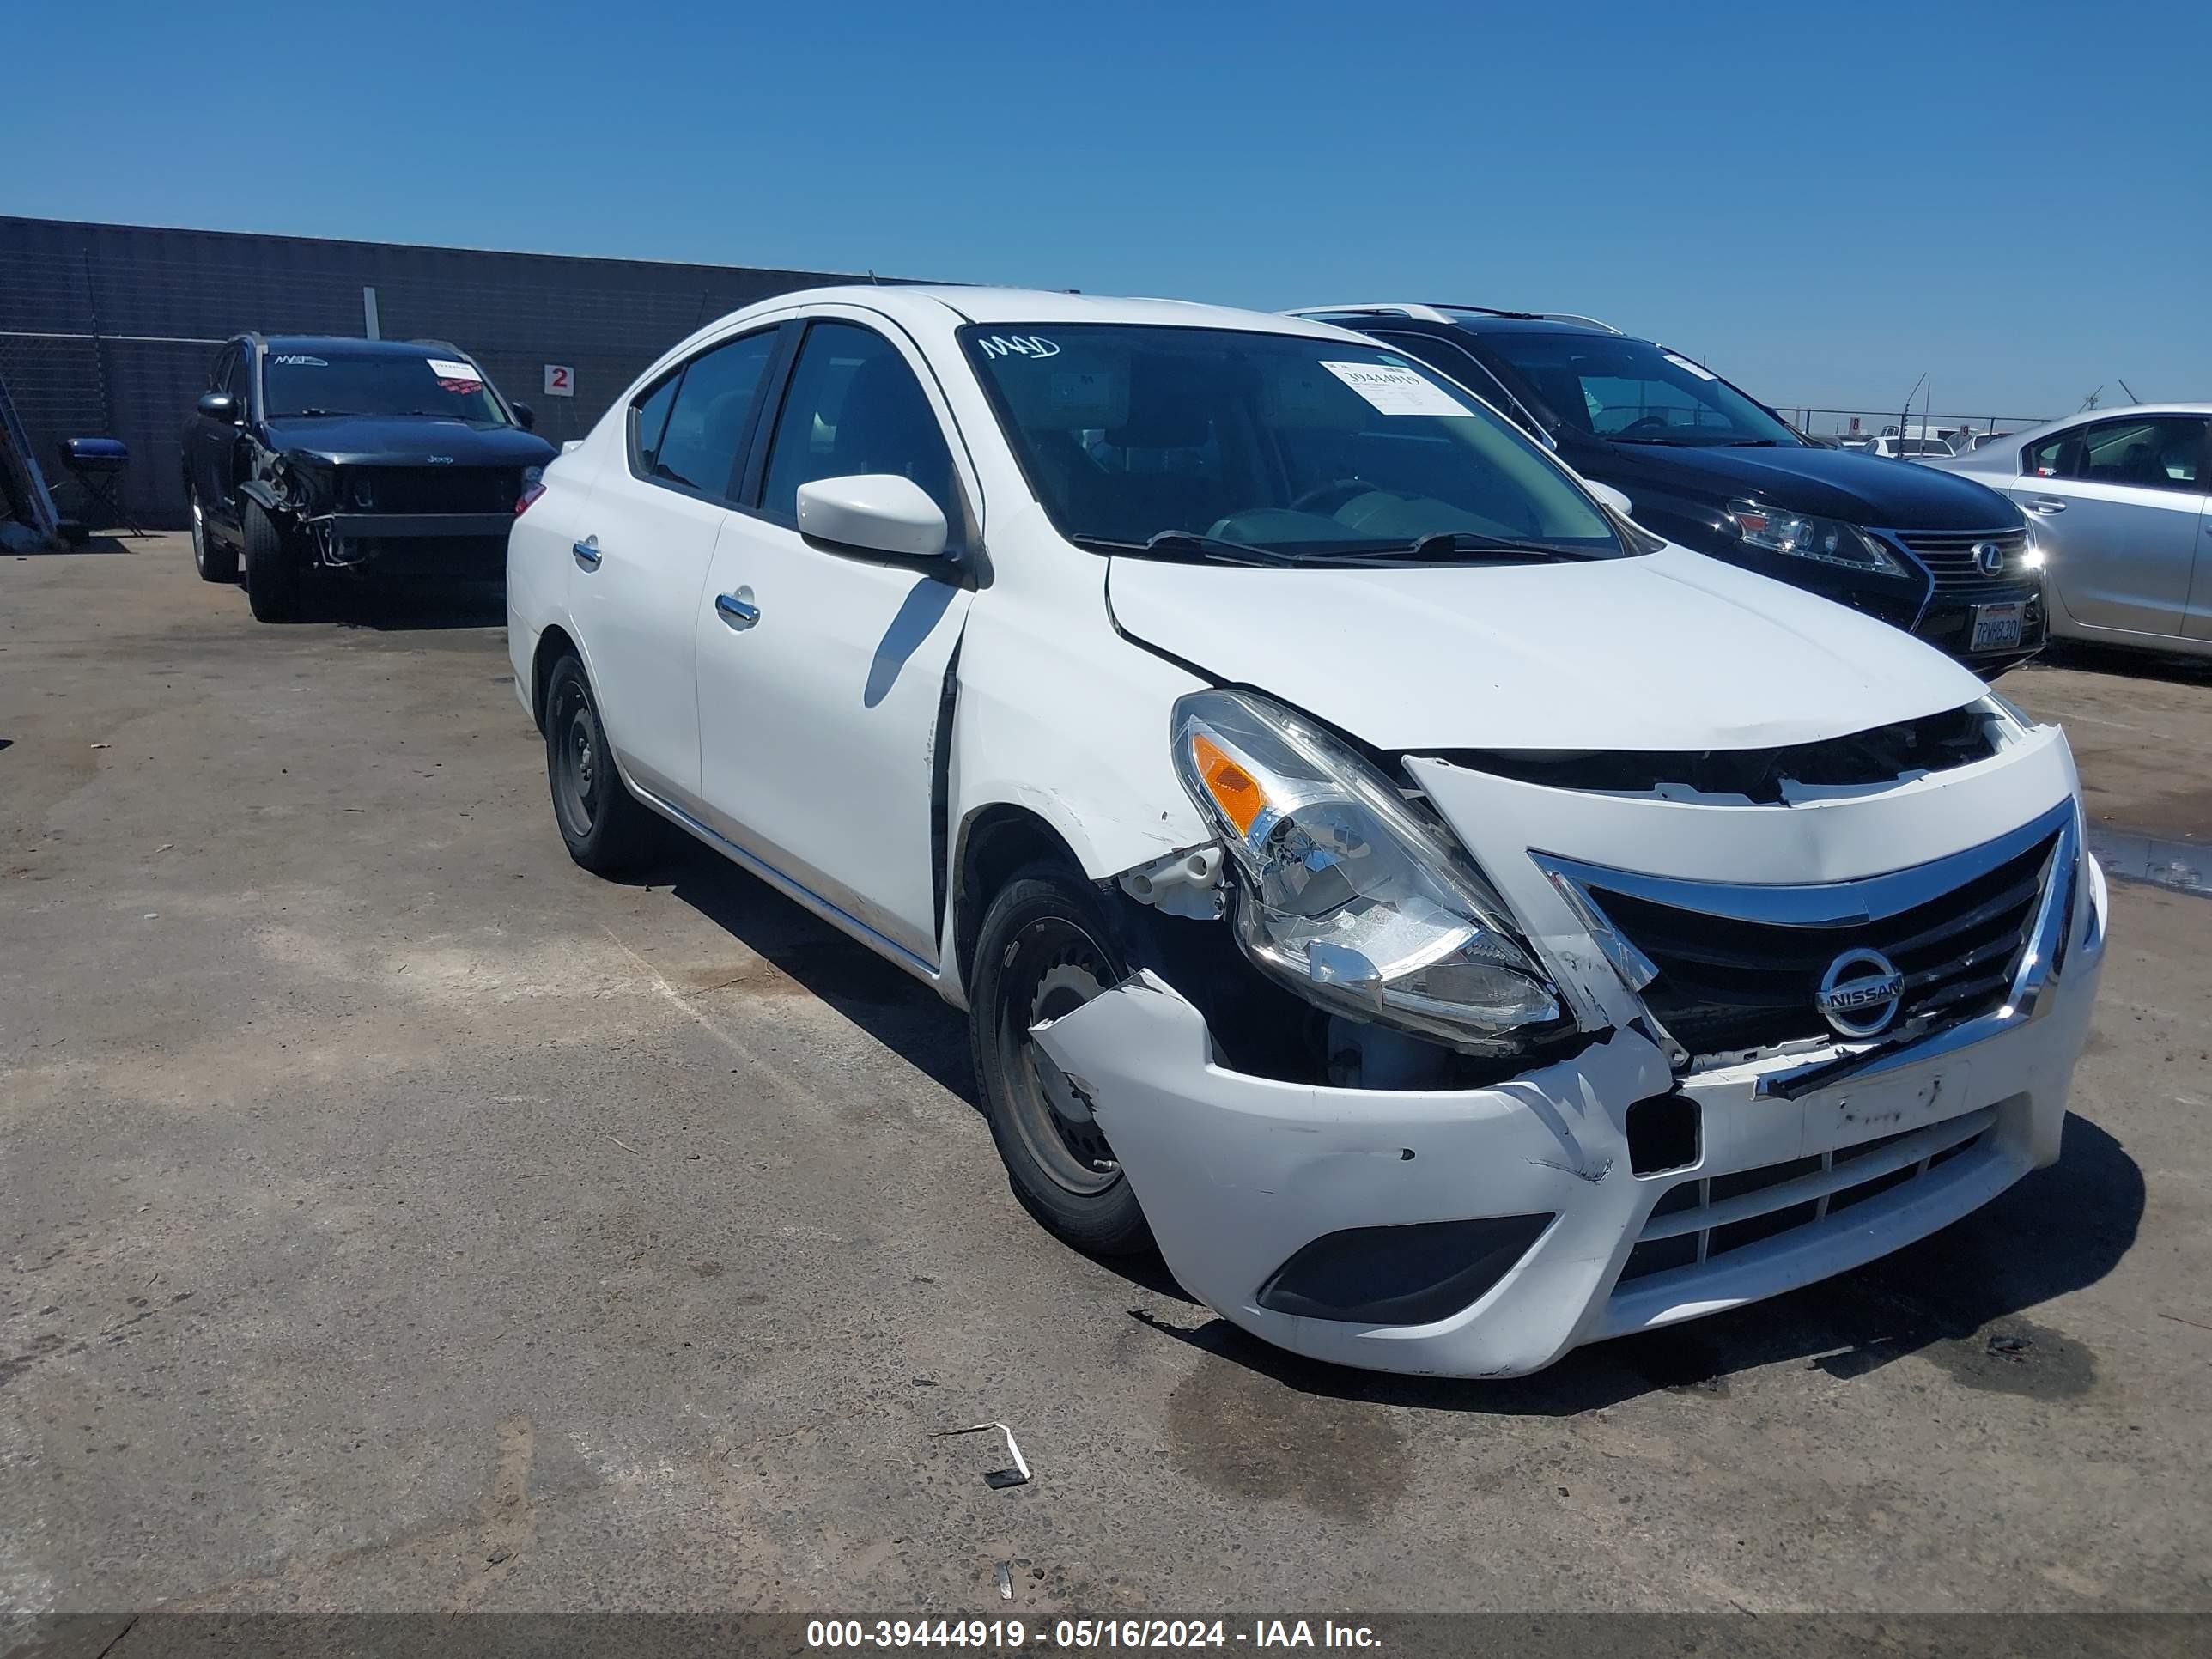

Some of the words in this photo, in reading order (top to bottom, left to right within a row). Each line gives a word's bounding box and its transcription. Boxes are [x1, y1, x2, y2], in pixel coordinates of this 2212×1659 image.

[978, 336, 1060, 359] MAD
[552, 368, 568, 388] 2
[1344, 372, 1420, 385] 39444919
[1829, 975, 1903, 1009] NISSAN
